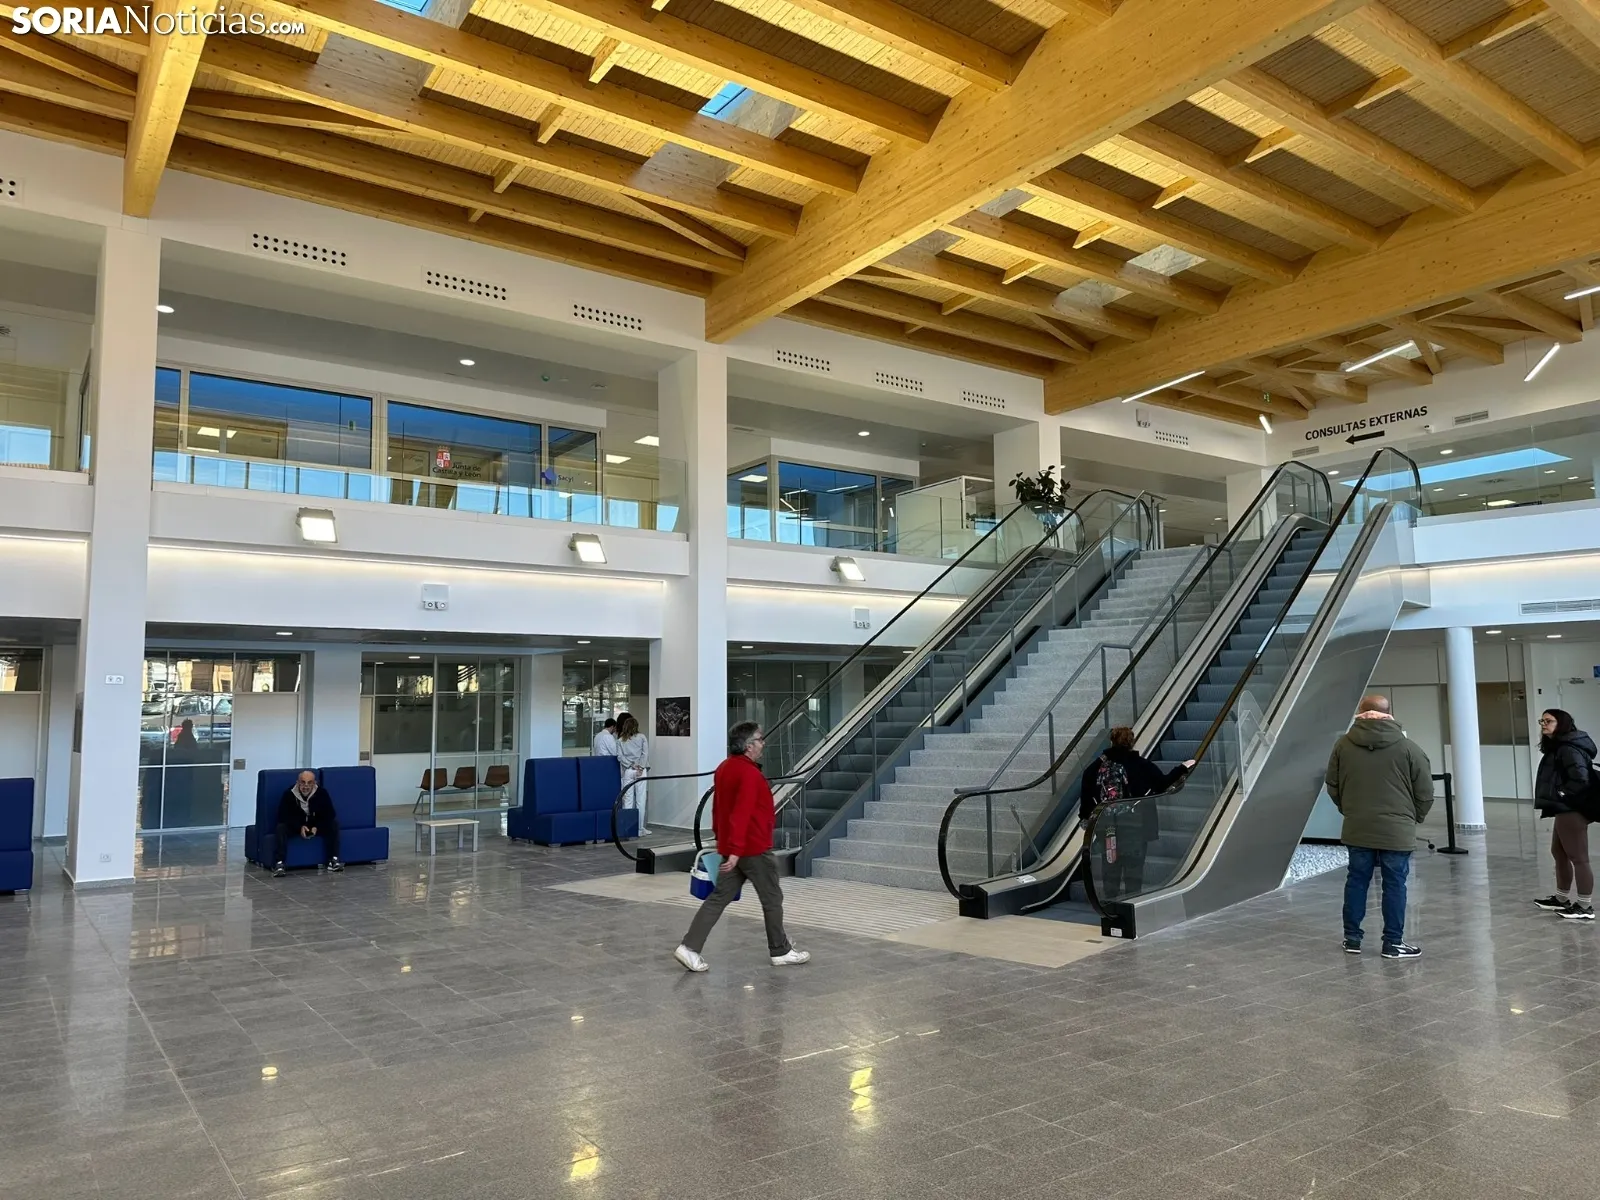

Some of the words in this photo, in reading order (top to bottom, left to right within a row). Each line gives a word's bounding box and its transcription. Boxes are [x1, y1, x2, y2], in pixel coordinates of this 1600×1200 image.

[1305, 419, 1367, 441] CONSULTAS
[1369, 405, 1428, 427] EXTERNAS
[452, 462, 471, 470] Junta
[558, 474, 574, 483] Sacyl
